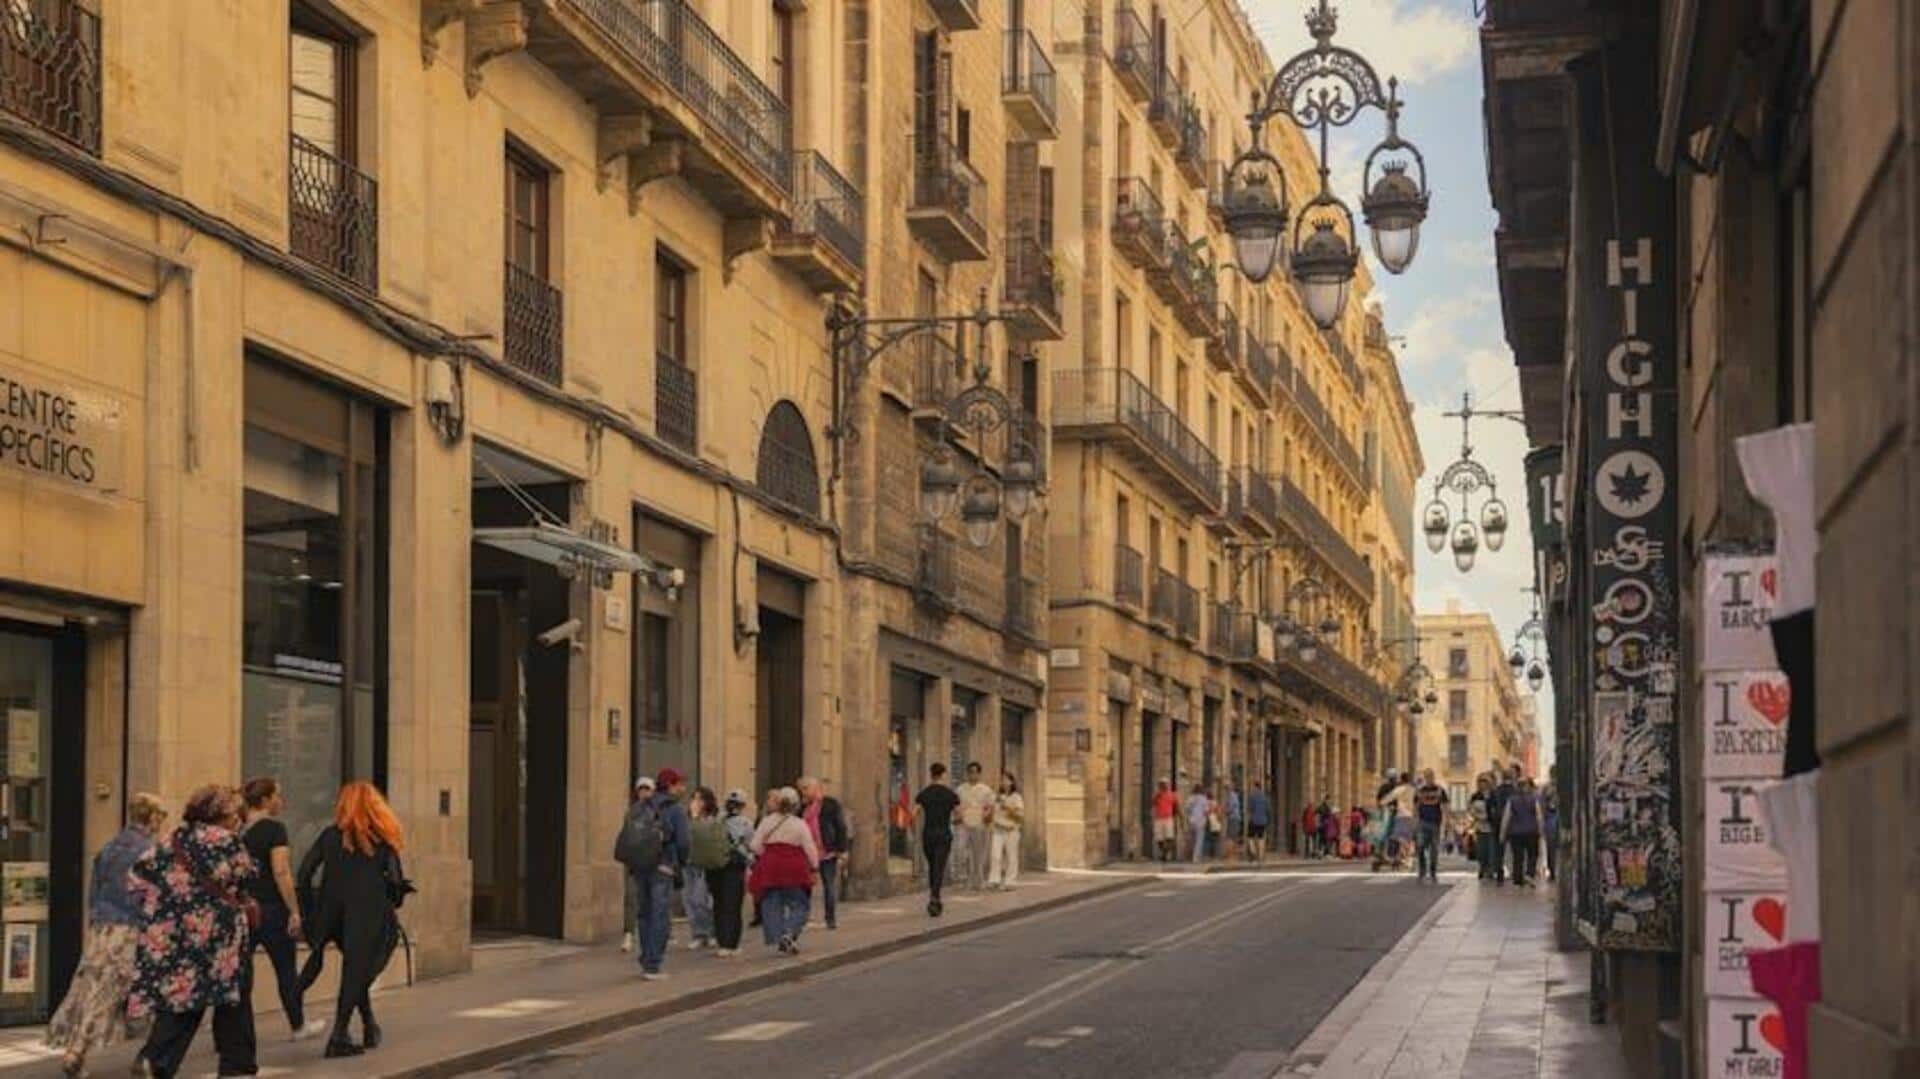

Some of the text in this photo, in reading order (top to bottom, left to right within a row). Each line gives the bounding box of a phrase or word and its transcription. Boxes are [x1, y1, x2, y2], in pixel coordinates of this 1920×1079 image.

[1606, 239, 1652, 438] HIGH
[1714, 681, 1738, 727] I
[1720, 786, 1753, 824] I
[1720, 898, 1744, 943] I
[1732, 1014, 1758, 1055] I
